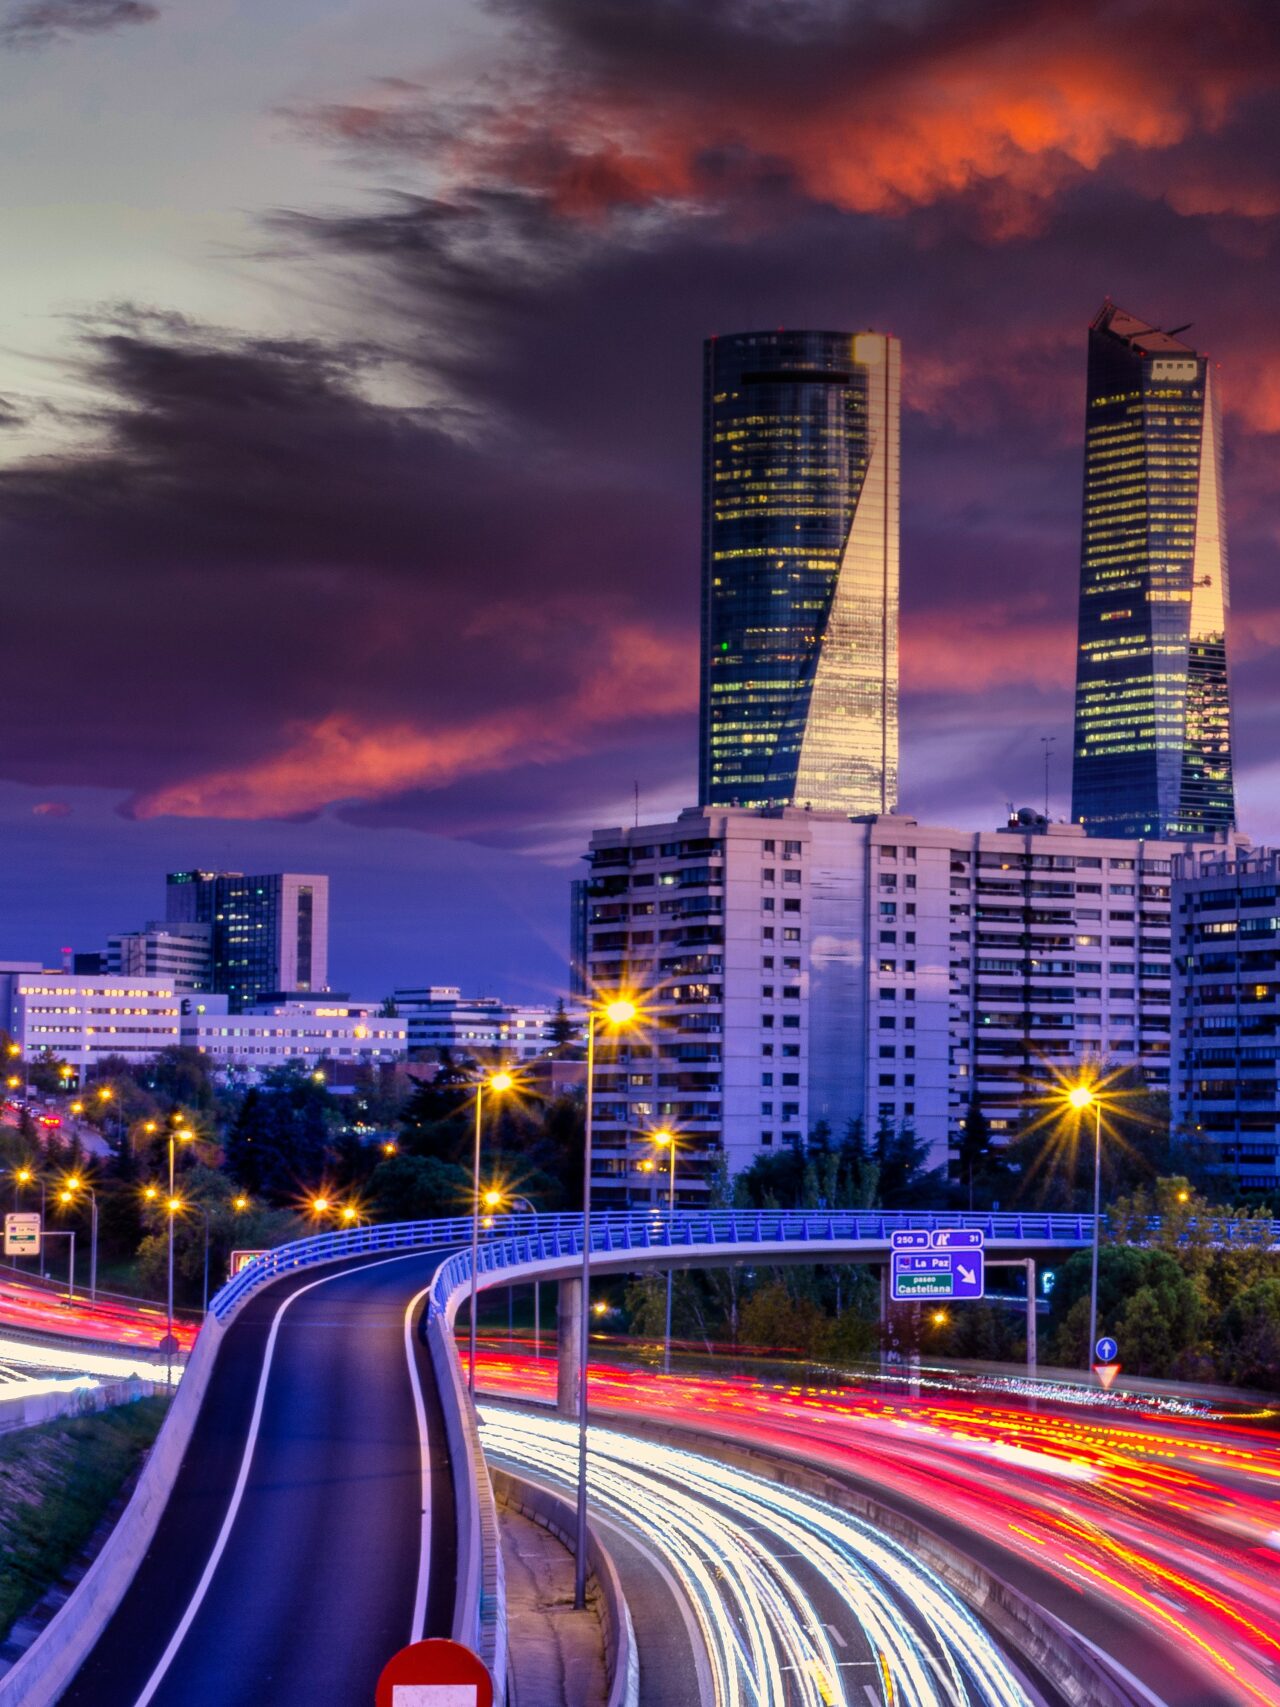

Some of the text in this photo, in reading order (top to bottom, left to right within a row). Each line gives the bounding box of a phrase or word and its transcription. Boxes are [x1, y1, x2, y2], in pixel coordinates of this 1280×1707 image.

[896, 1236, 914, 1244] 250
[969, 1235, 979, 1243] 31
[915, 1258, 949, 1268] La Paz
[913, 1276, 936, 1284] paseo
[898, 1284, 951, 1294] Castellana
